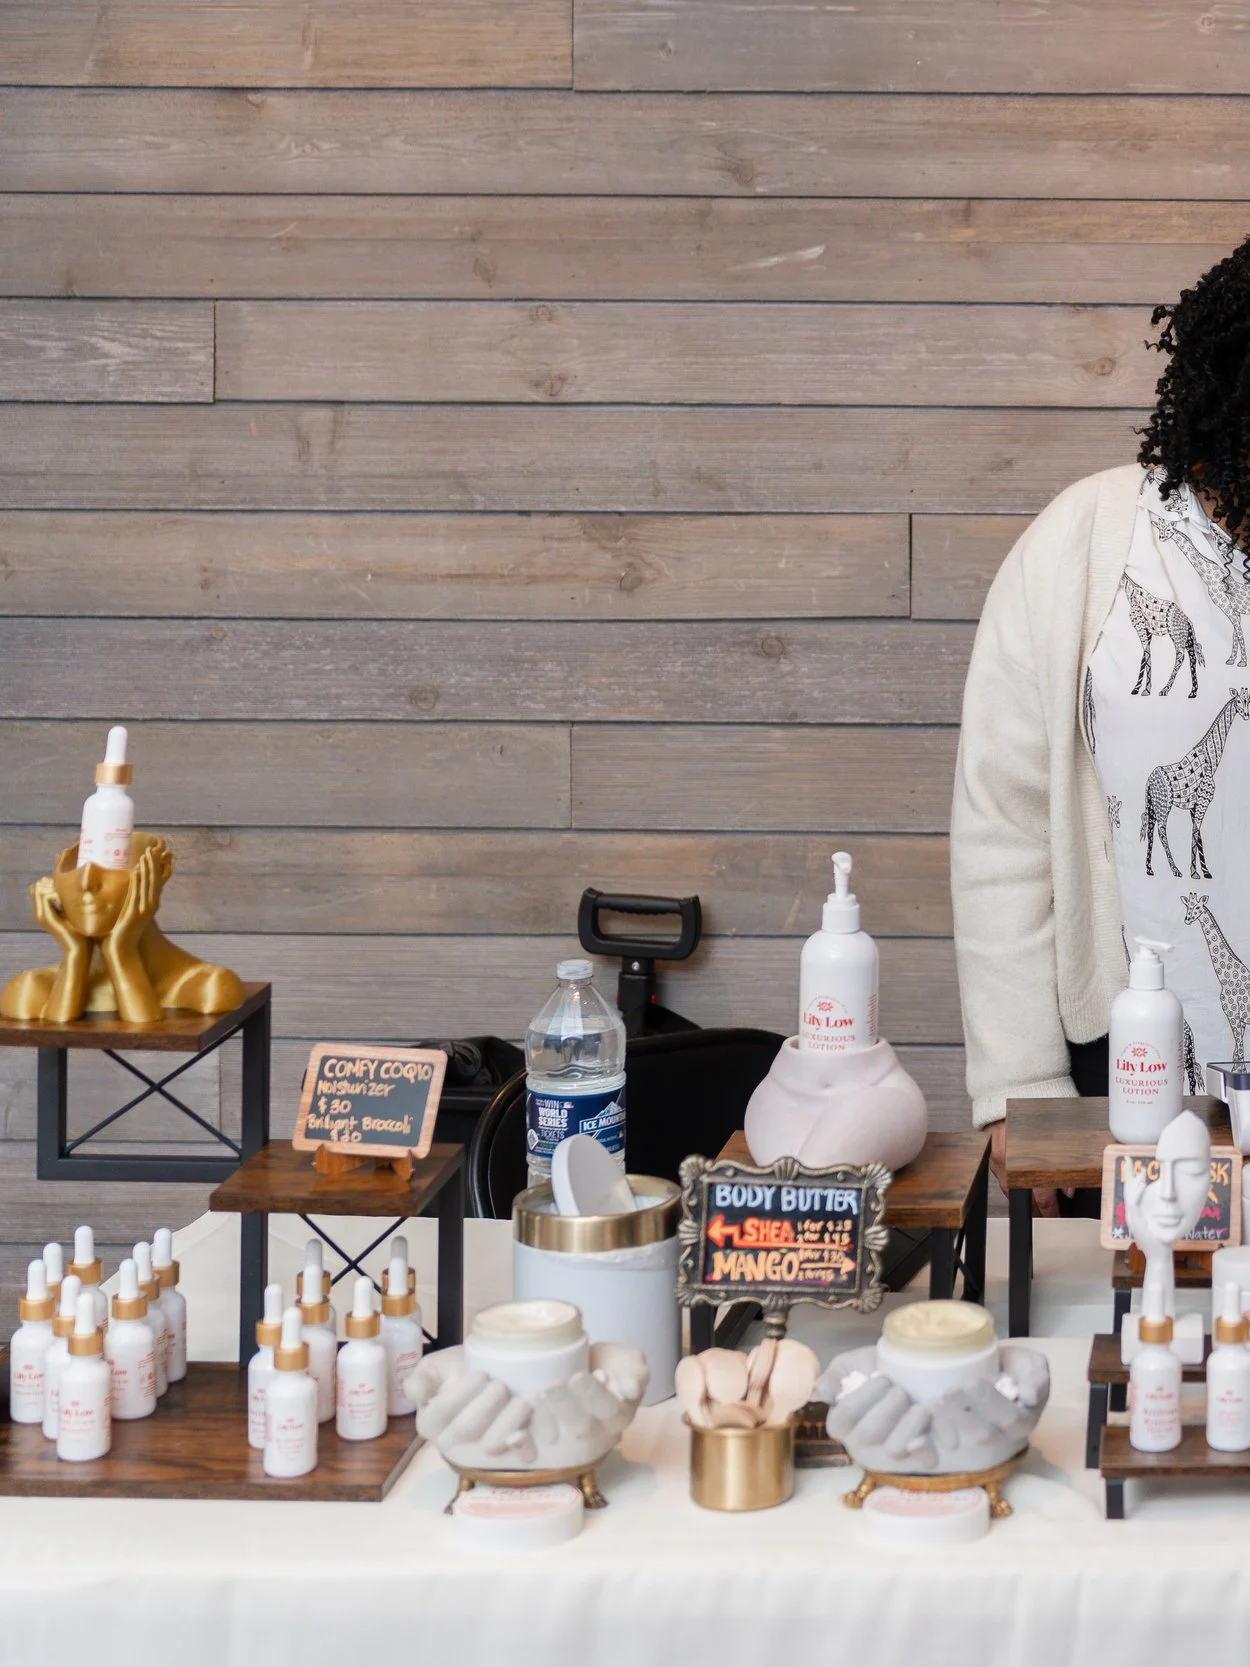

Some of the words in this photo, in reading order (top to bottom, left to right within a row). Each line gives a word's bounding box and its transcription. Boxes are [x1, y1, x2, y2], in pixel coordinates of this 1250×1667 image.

[803, 1012, 822, 1030] Lily
[826, 1017, 854, 1028] Low
[808, 1043, 845, 1051] LOTION
[324, 1058, 378, 1080] COMFY
[380, 1062, 432, 1084] COQ10
[1116, 1058, 1137, 1076] Lily
[1140, 1062, 1167, 1072] Low
[1116, 1076, 1168, 1087] LUXURIOUS
[545, 1099, 559, 1108] WIN
[539, 1108, 568, 1118] WORLD
[539, 1117, 568, 1127] SERIES
[583, 1120, 597, 1131] ICE
[541, 1130, 564, 1139] TICKETS
[716, 1185, 776, 1210] BODY
[781, 1187, 859, 1215] BUTTER
[742, 1217, 795, 1242] SHEA
[712, 1251, 800, 1282] MANGO
